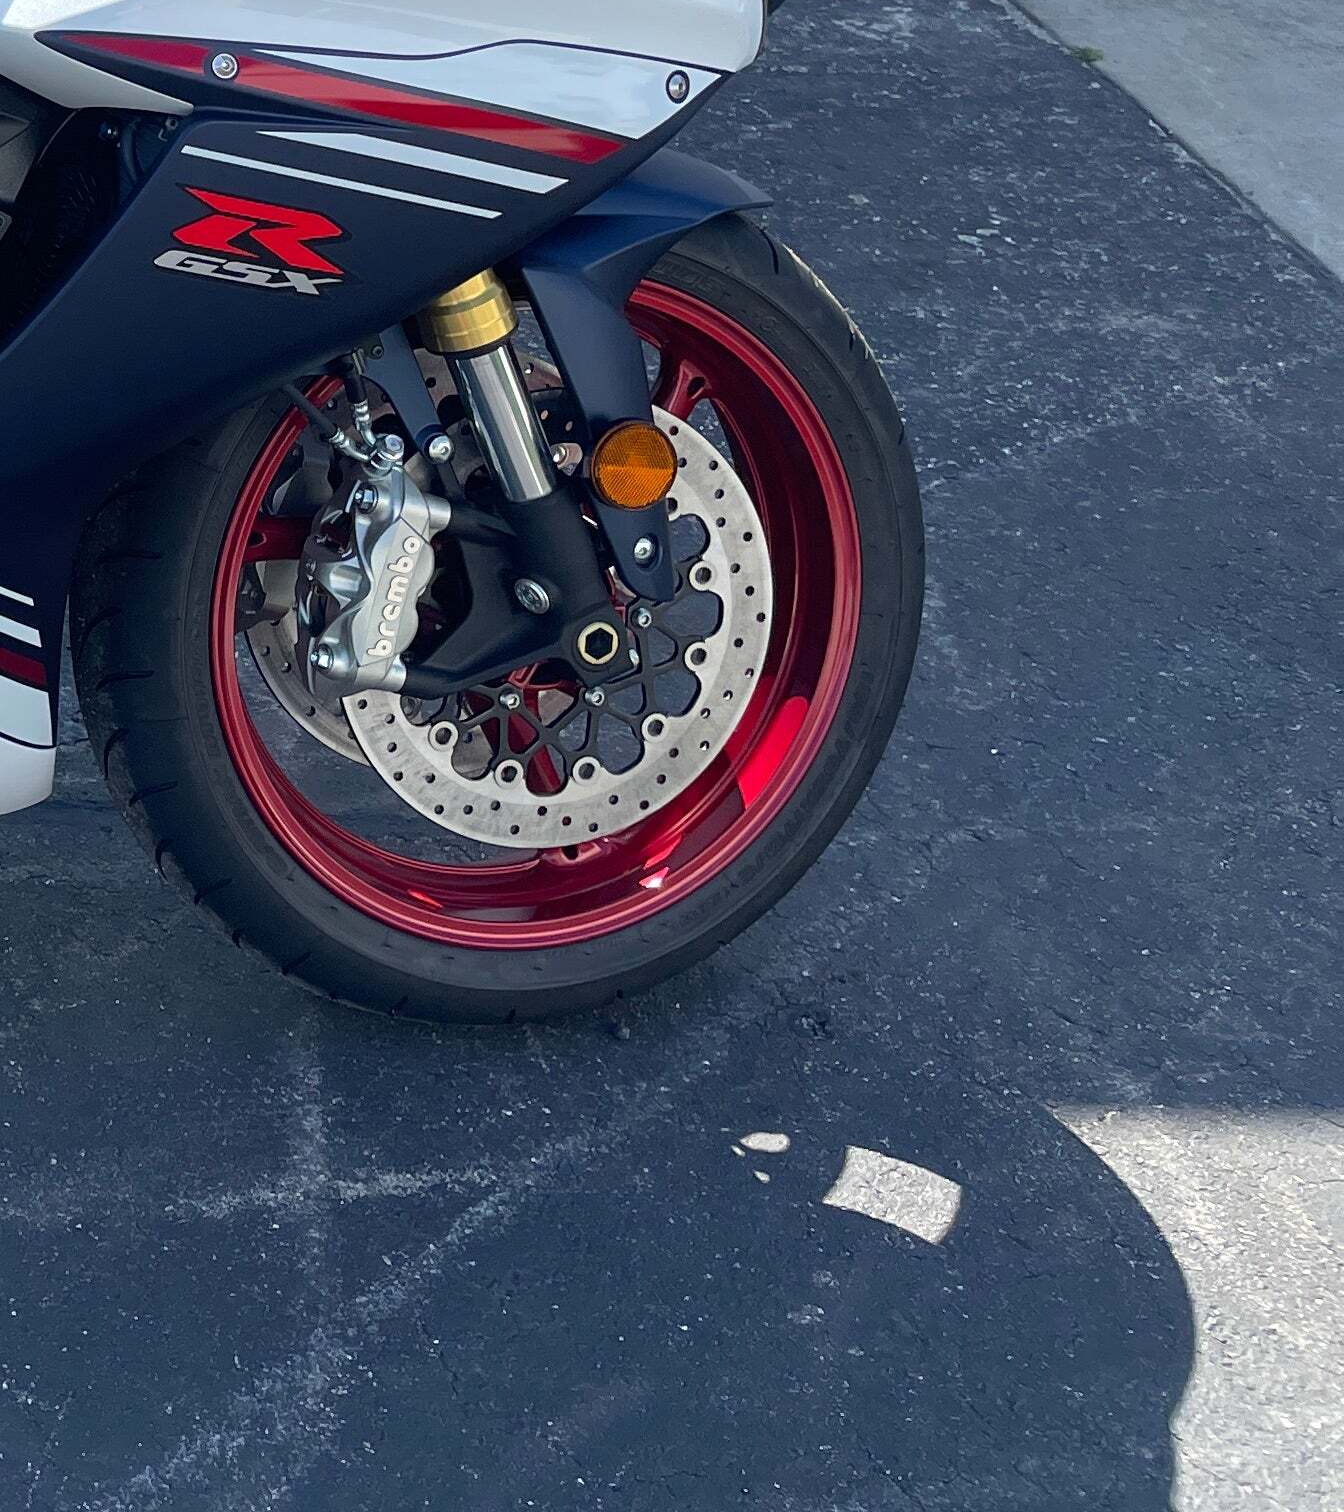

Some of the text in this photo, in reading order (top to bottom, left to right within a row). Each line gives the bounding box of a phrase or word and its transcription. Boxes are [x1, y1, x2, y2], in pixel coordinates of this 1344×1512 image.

[153, 249, 344, 296] GSX
[172, 186, 345, 275] R
[367, 536, 422, 657] brembo
